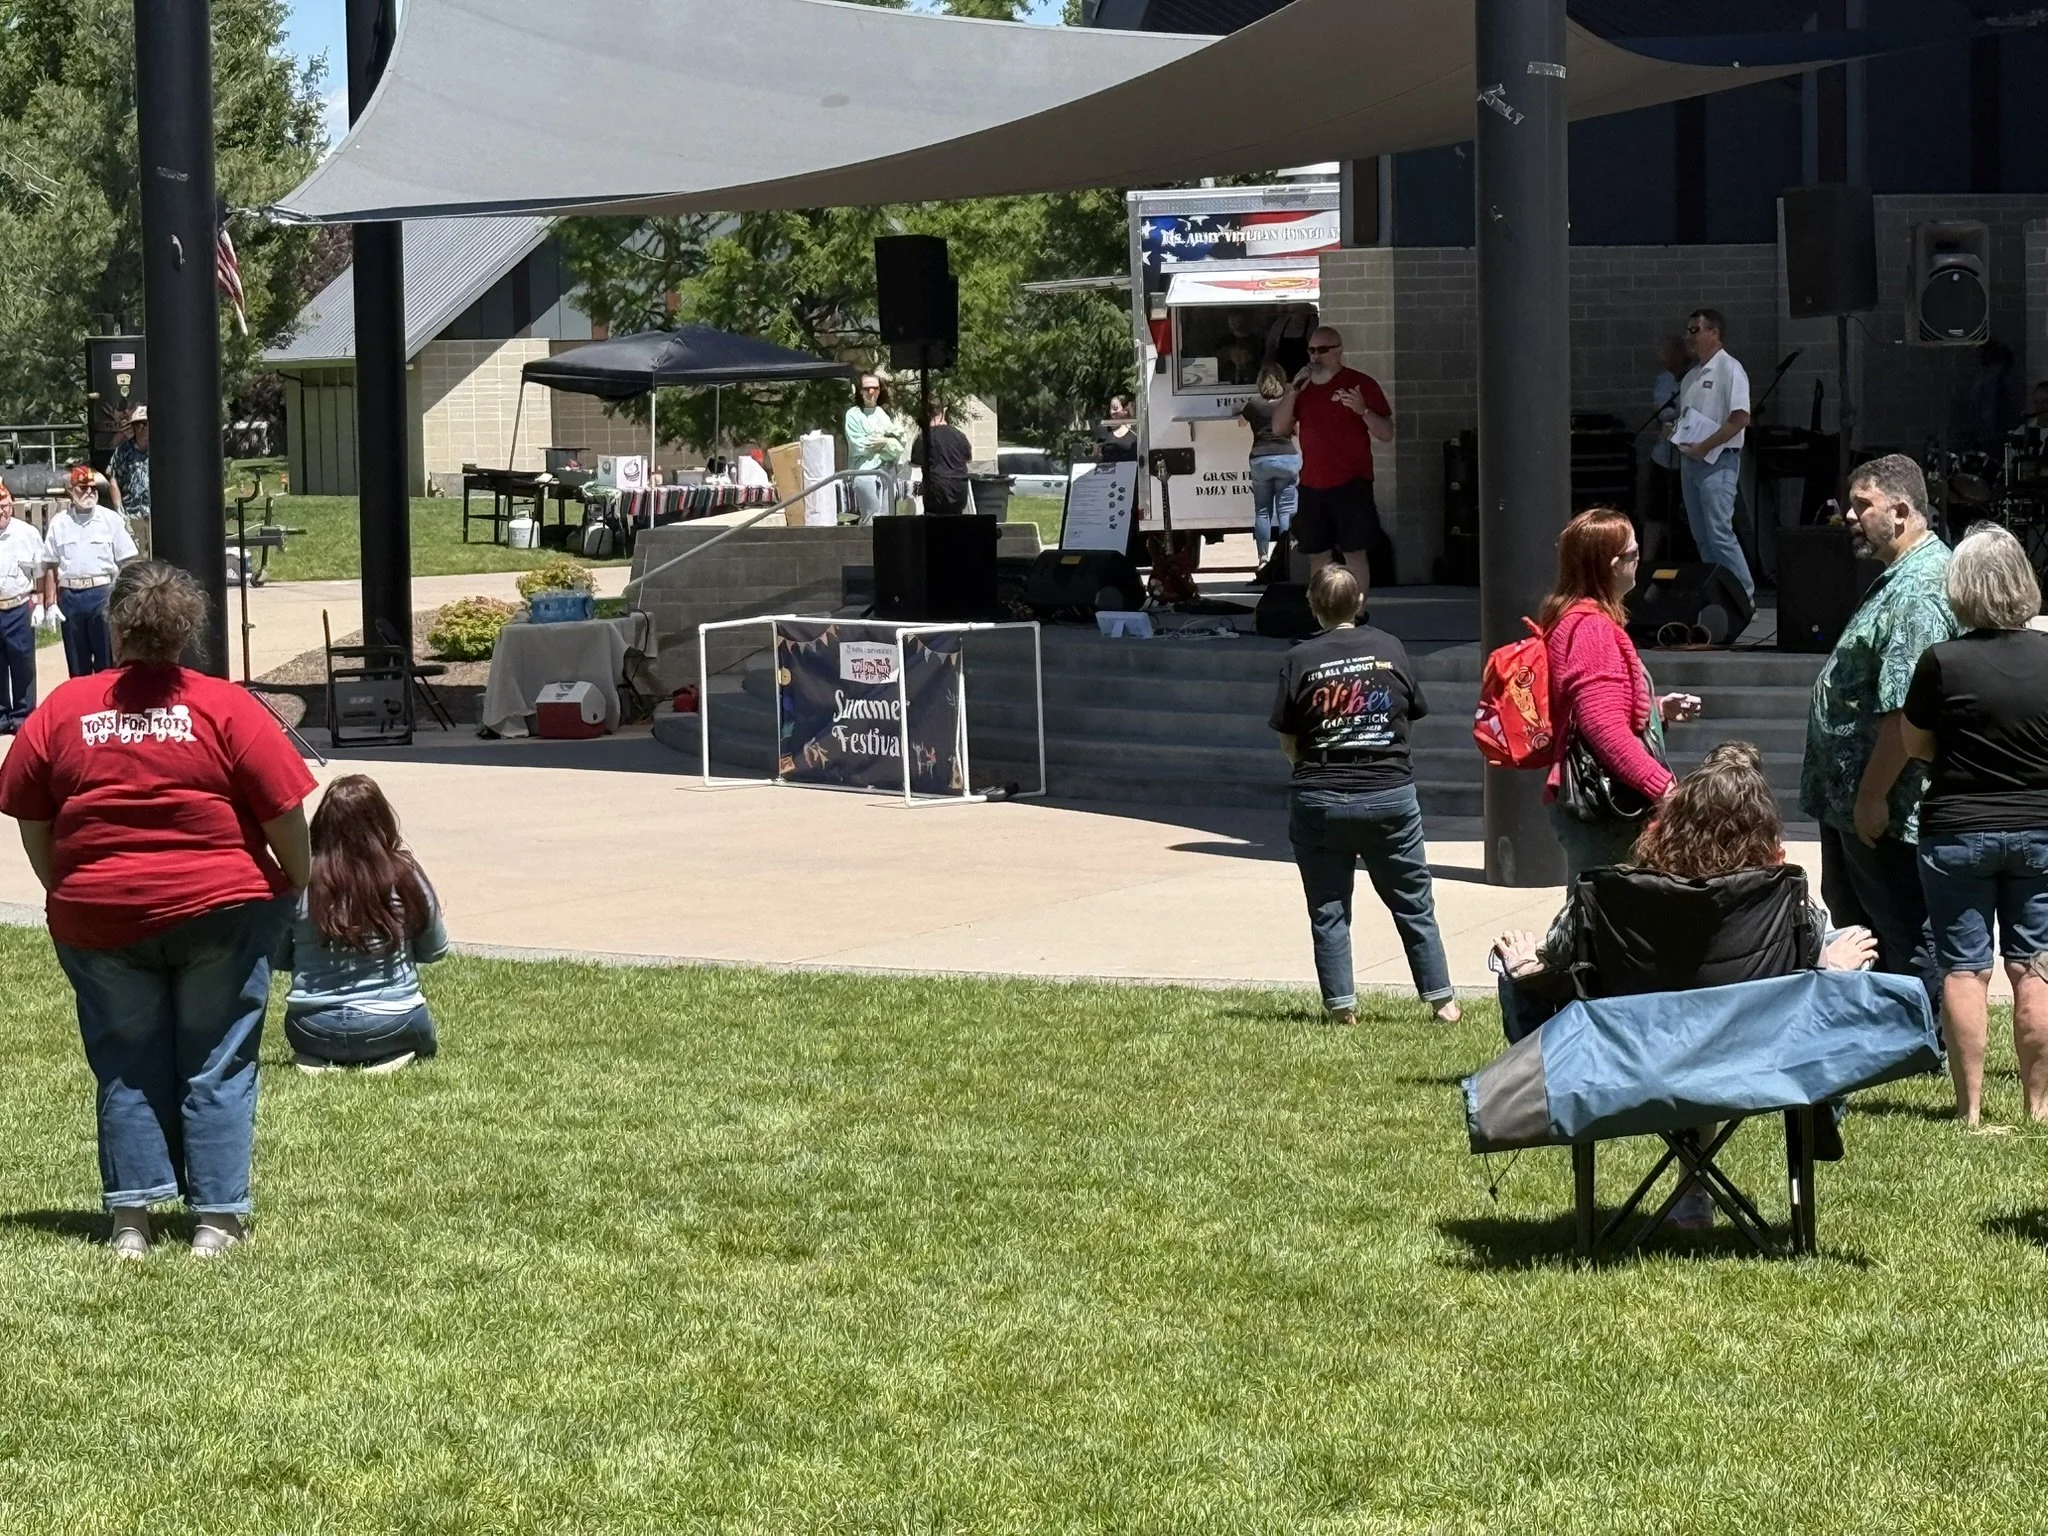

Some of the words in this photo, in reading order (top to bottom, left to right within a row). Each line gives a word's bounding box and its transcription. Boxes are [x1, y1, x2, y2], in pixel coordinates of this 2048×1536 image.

[1203, 472, 1237, 481] GRASS
[1196, 486, 1227, 495] DAILY
[1343, 662, 1373, 673] ABOUT
[833, 689, 909, 722] Summe
[84, 715, 114, 734] TOYS
[122, 715, 147, 731] FOR
[154, 717, 188, 732] TOTS
[832, 725, 901, 757] Festiva
